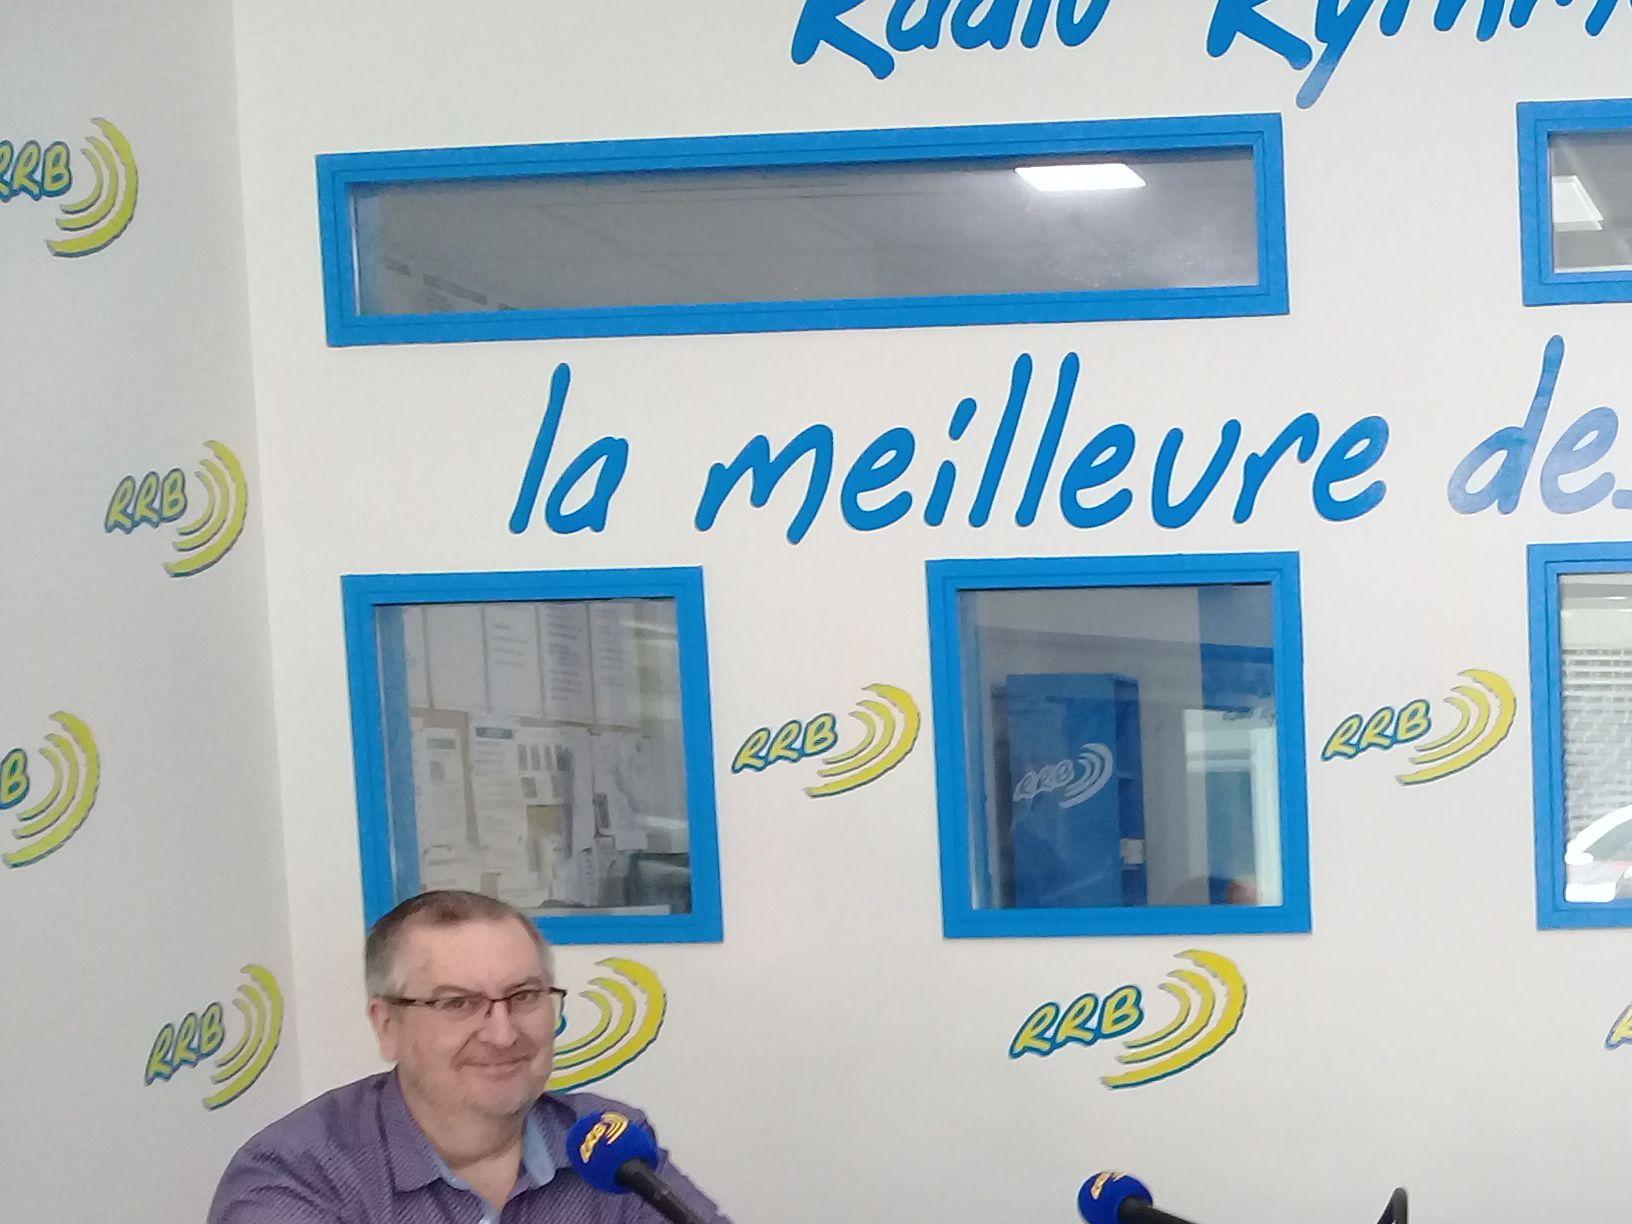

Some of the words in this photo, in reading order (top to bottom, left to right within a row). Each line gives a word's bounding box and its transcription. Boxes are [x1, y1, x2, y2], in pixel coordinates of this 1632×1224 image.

[508, 362, 629, 536] la
[695, 351, 1390, 545] meilleure
[105, 467, 188, 534] RRB
[731, 713, 838, 774] RRB
[1321, 699, 1431, 762] RRB
[144, 1001, 226, 1087] RRB
[1008, 984, 1143, 1060] RRB
